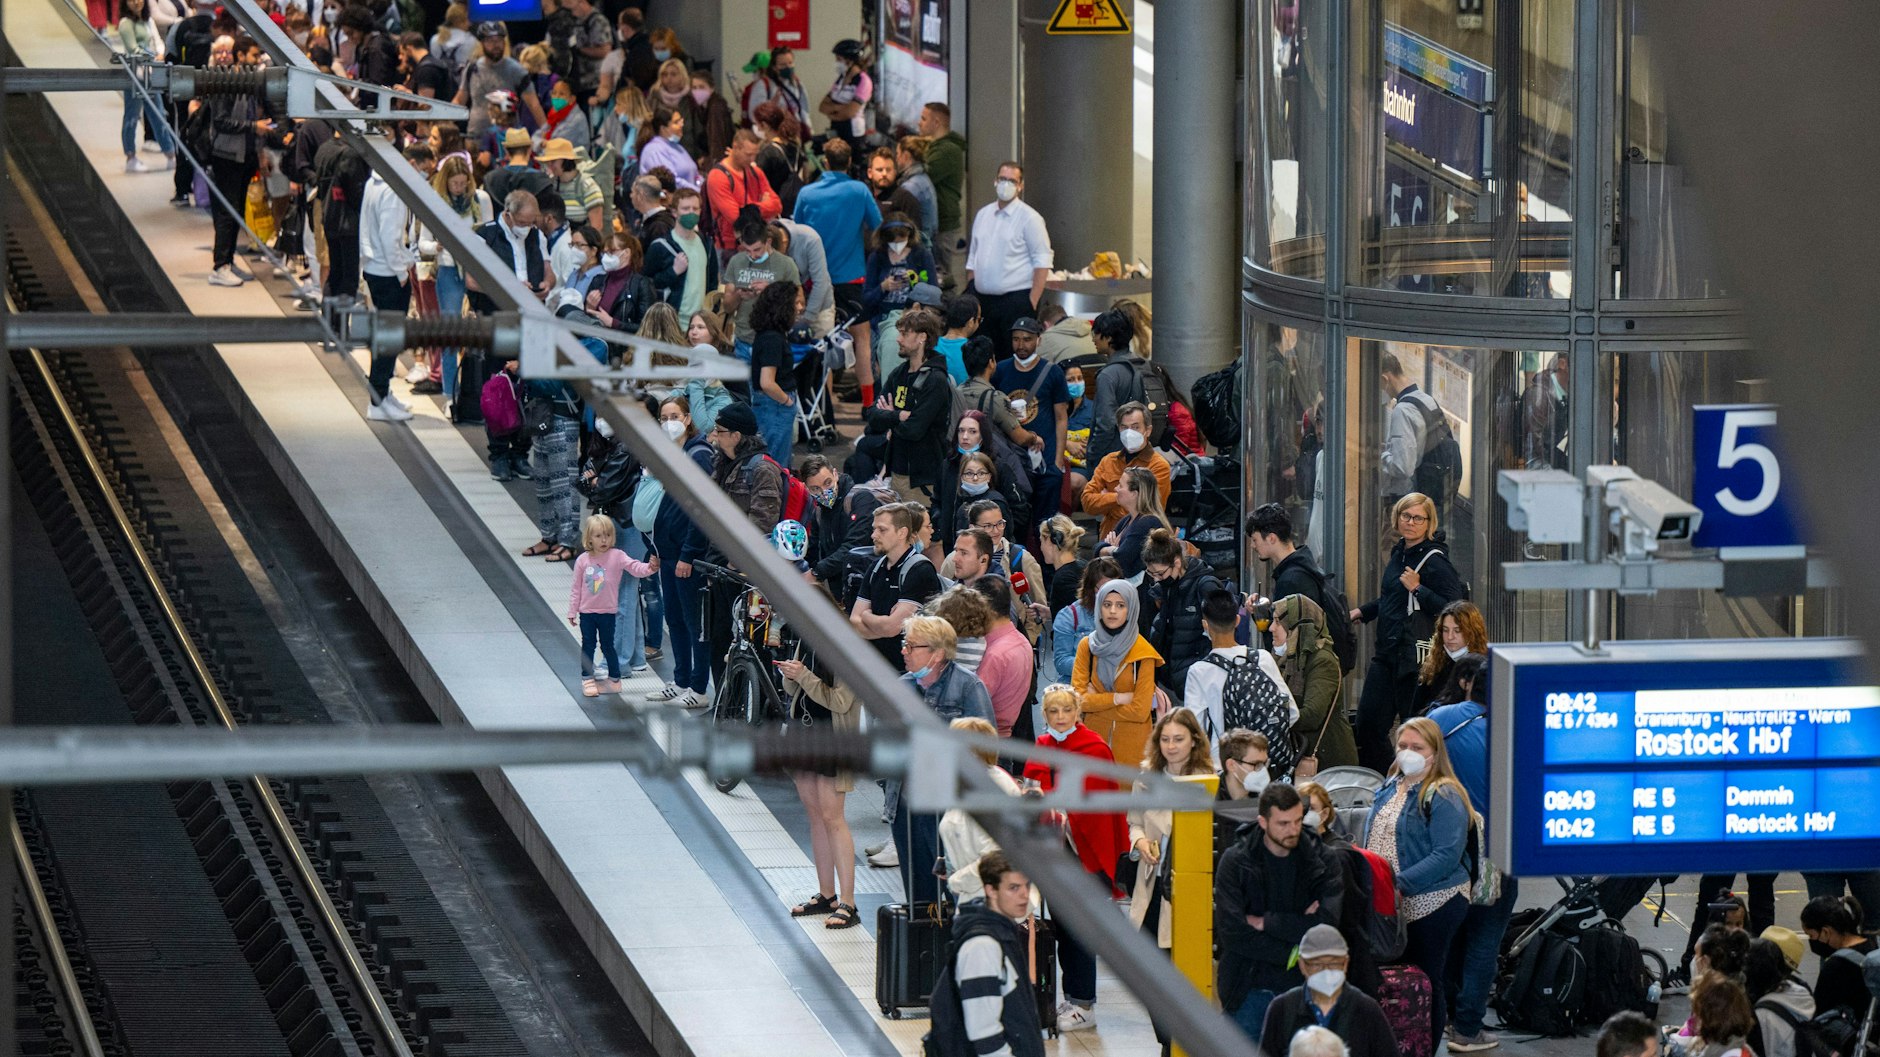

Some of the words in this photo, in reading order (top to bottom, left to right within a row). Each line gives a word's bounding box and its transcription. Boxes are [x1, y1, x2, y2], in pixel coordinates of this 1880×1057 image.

[1714, 410, 1781, 517] 5
[1546, 714, 1562, 729] RE
[1808, 709, 1851, 724] Waren
[1636, 728, 1740, 757] Rostock
[1749, 726, 1792, 753] Hbf
[1633, 788, 1656, 808] RE
[1662, 788, 1676, 807] 5
[1727, 786, 1793, 806] Demmin
[1546, 818, 1595, 838] 10:42
[1633, 816, 1656, 835] RE
[1662, 815, 1675, 834] 5
[1726, 813, 1798, 833] Rostock
[1804, 812, 1835, 831] Hbf
